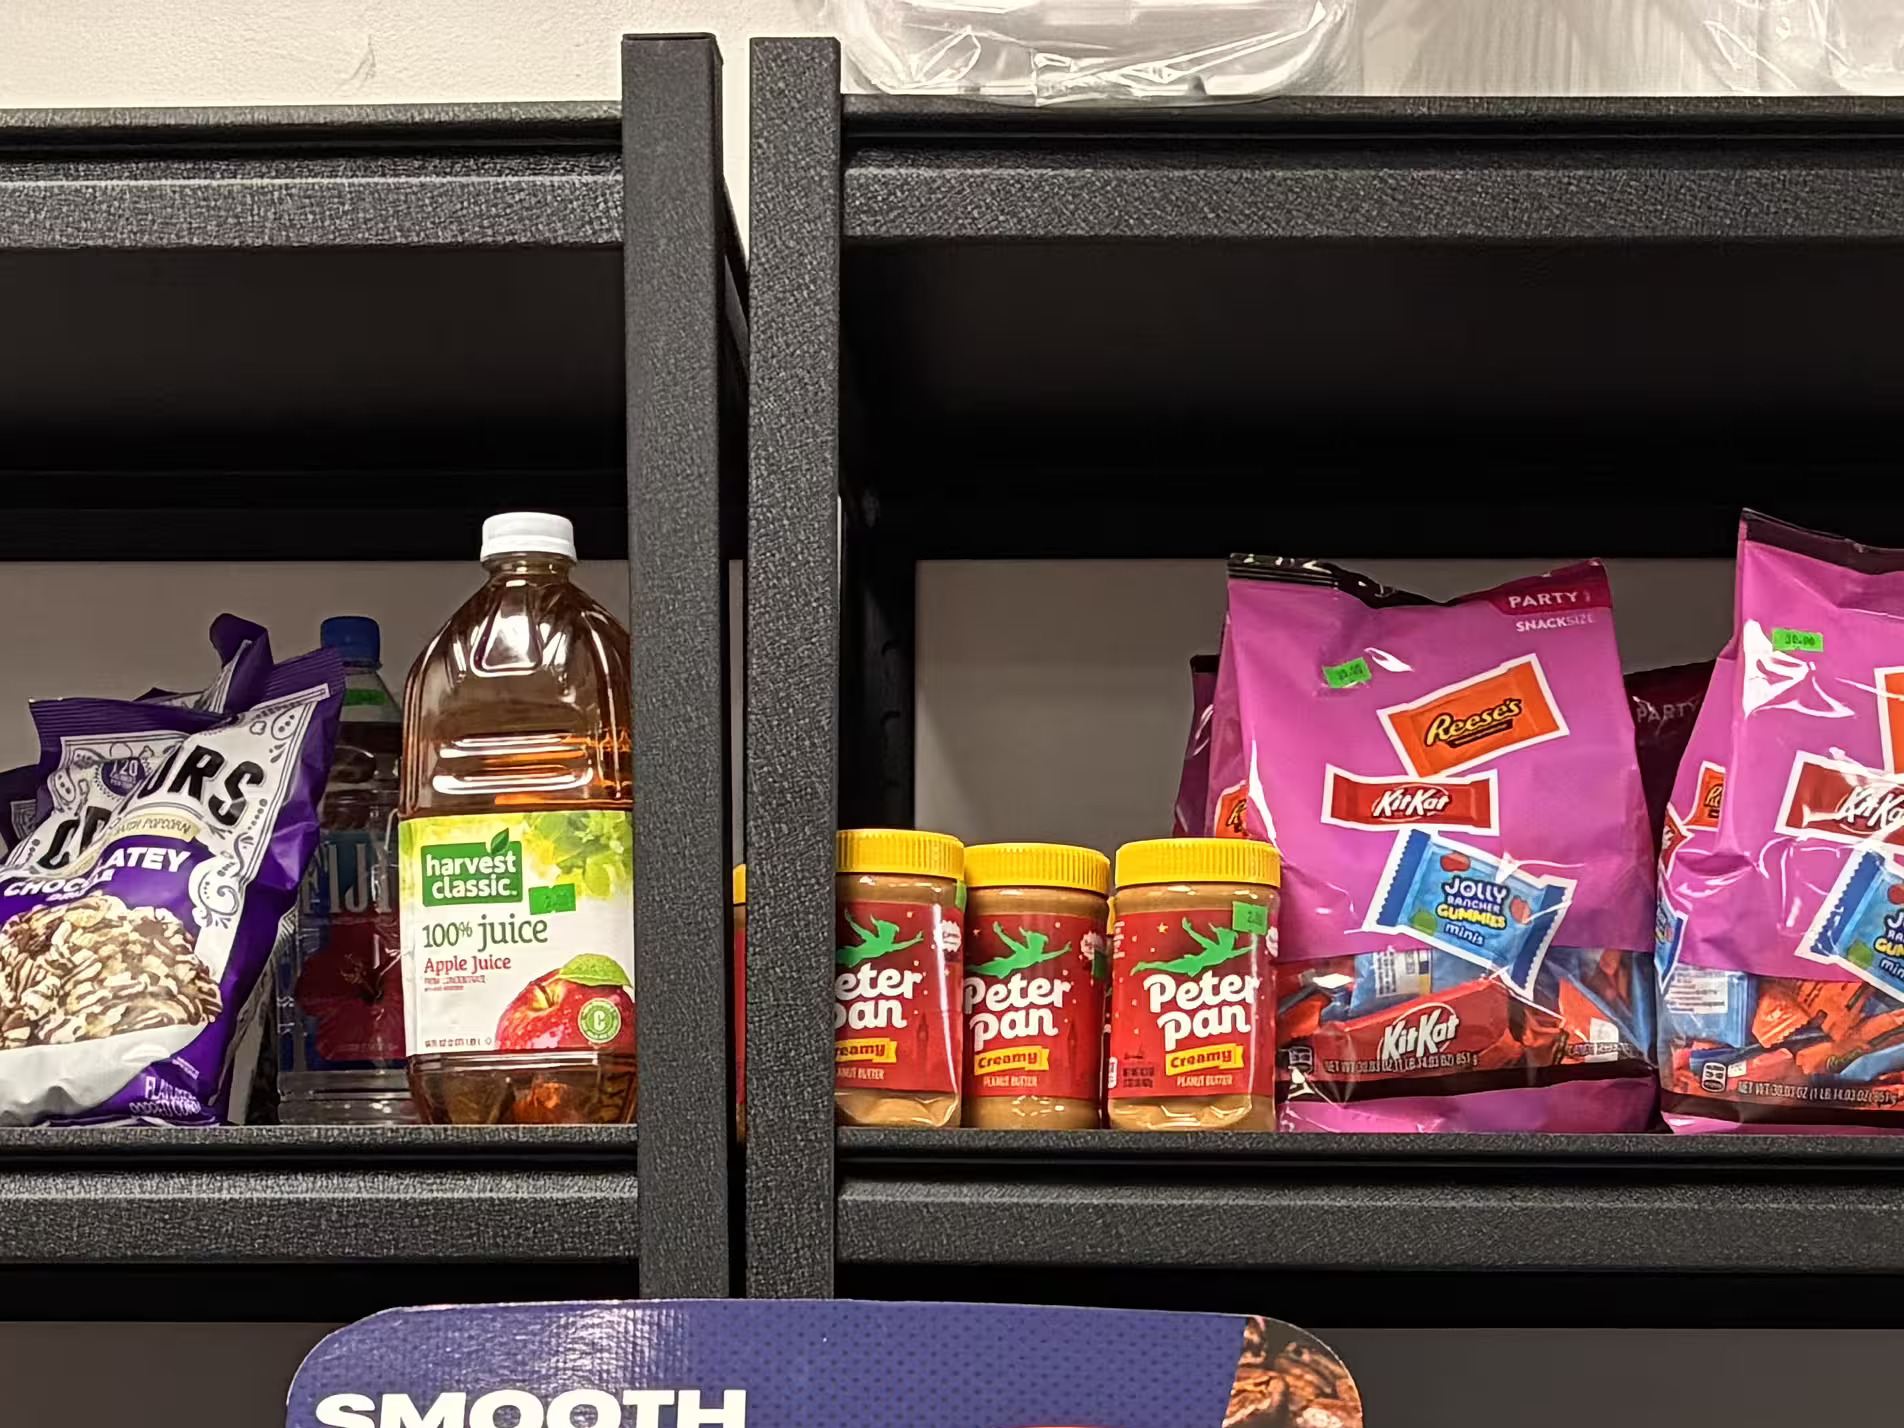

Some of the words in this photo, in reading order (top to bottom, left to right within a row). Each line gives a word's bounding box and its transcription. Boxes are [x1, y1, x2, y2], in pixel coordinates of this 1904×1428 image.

[1509, 591, 1578, 608] PARTY
[425, 851, 517, 879] harvest
[1445, 876, 1508, 904] JOLLY
[422, 921, 473, 949] 100%
[478, 913, 548, 946] juice
[425, 955, 468, 978] Apple
[473, 952, 512, 972] Juice
[964, 971, 1072, 1013] Peter
[1144, 971, 1262, 1013] Peter
[970, 1008, 1060, 1051] Pan
[1157, 1004, 1253, 1050] Pan
[1170, 1048, 1233, 1067] Creamy
